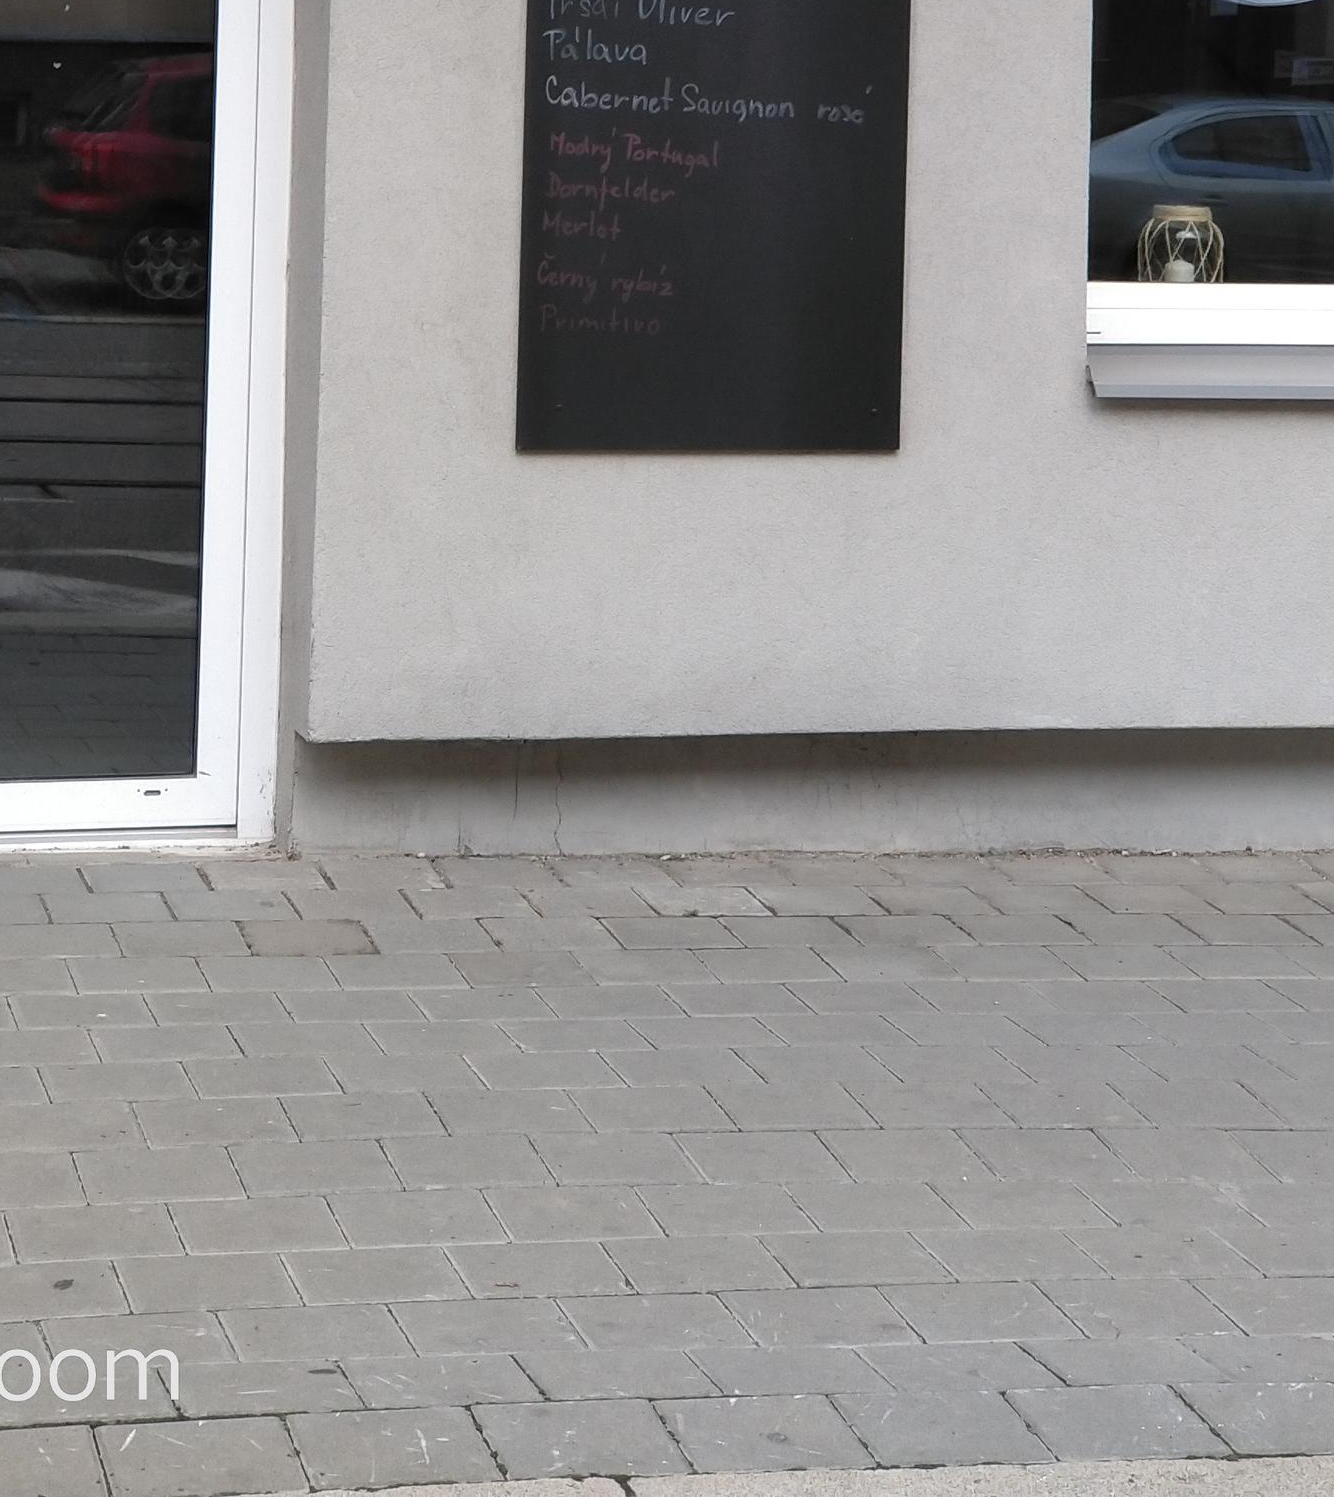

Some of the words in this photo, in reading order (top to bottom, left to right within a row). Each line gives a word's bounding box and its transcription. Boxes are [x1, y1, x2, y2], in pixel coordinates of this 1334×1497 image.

[542, 25, 648, 66] Pálava
[545, 75, 674, 114] Cabernet
[681, 83, 795, 122] Savignon
[550, 127, 616, 174] Modrý
[623, 133, 720, 178] Portugal
[546, 170, 677, 212] Dornfelder
[542, 210, 622, 242] Merlot
